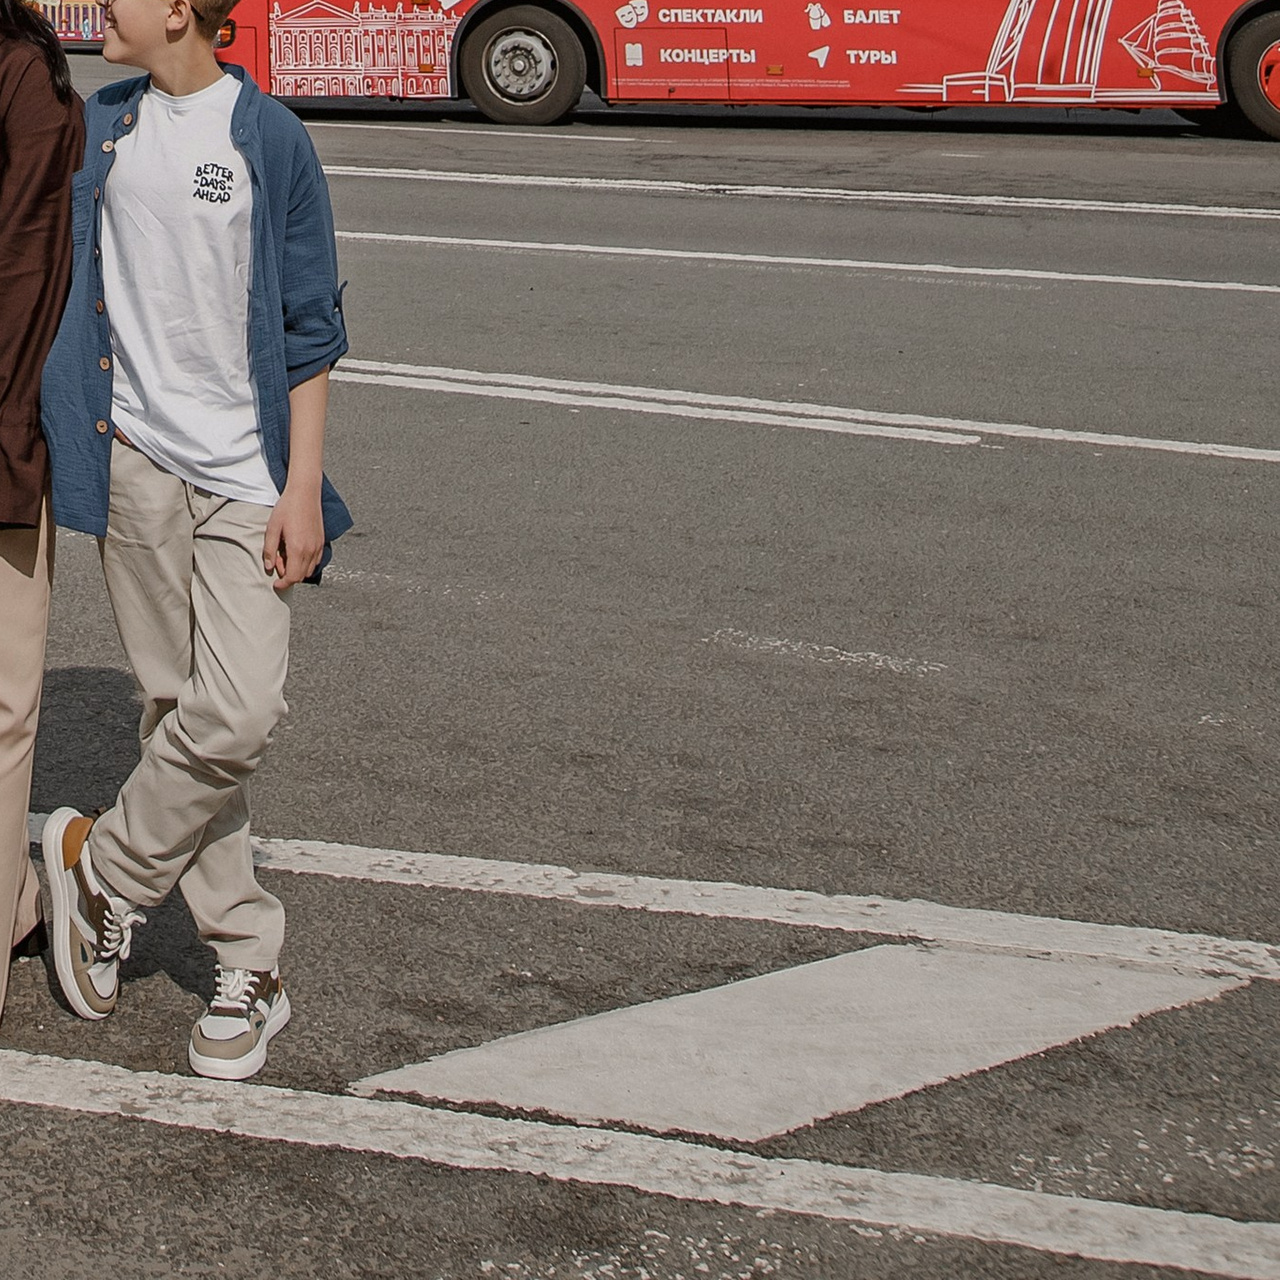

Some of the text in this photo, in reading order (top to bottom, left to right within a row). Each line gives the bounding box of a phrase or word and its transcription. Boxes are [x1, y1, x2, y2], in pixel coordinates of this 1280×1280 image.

[658, 9, 763, 23] СПЕКТАКЛИ
[843, 9, 901, 24] БАЛЕТ
[660, 49, 756, 65] КОНЦЕРТЫ
[846, 50, 897, 64] ТУРЫ
[195, 163, 234, 182] BETTER
[193, 188, 231, 204] AHEAD
